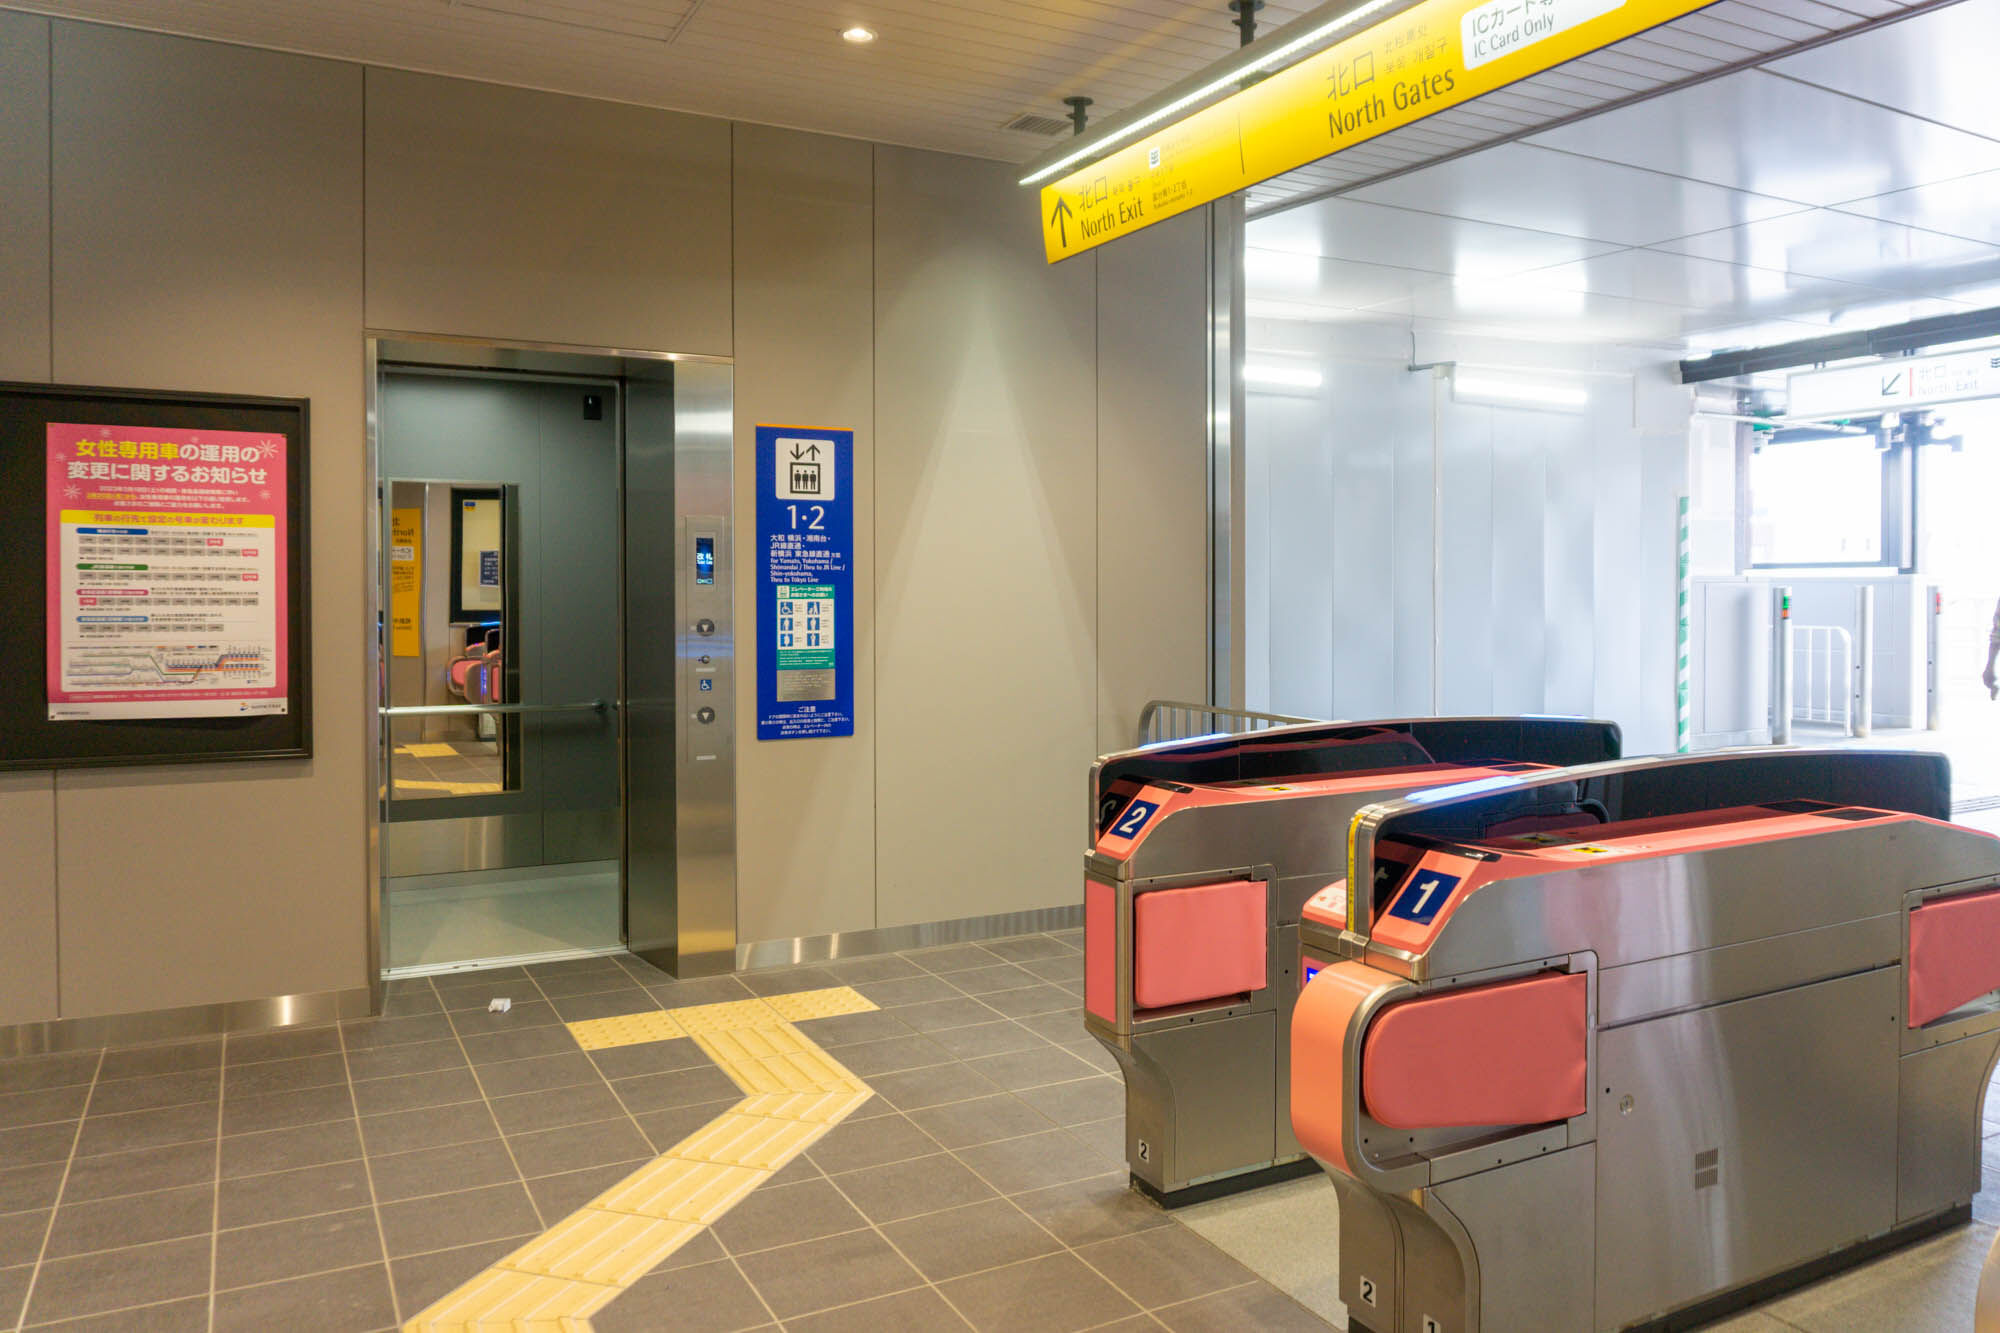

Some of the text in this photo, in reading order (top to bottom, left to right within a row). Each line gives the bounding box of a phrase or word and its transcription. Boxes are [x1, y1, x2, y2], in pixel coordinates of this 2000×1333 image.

[1473, 13, 1555, 58] IC Card Only
[1327, 50, 1376, 101] 北口
[1329, 69, 1455, 139] North Gates
[1078, 175, 1108, 212] 北口
[1080, 208, 1115, 240] North
[1119, 197, 1144, 225] Exit
[75, 438, 261, 464] 女性専用車の運用の
[67, 460, 268, 485] 変更に関するお知らせ
[1119, 806, 1147, 834] 2
[1411, 879, 1440, 914] 1
[1140, 1142, 1148, 1160] 2
[1362, 1280, 1373, 1302] 2
